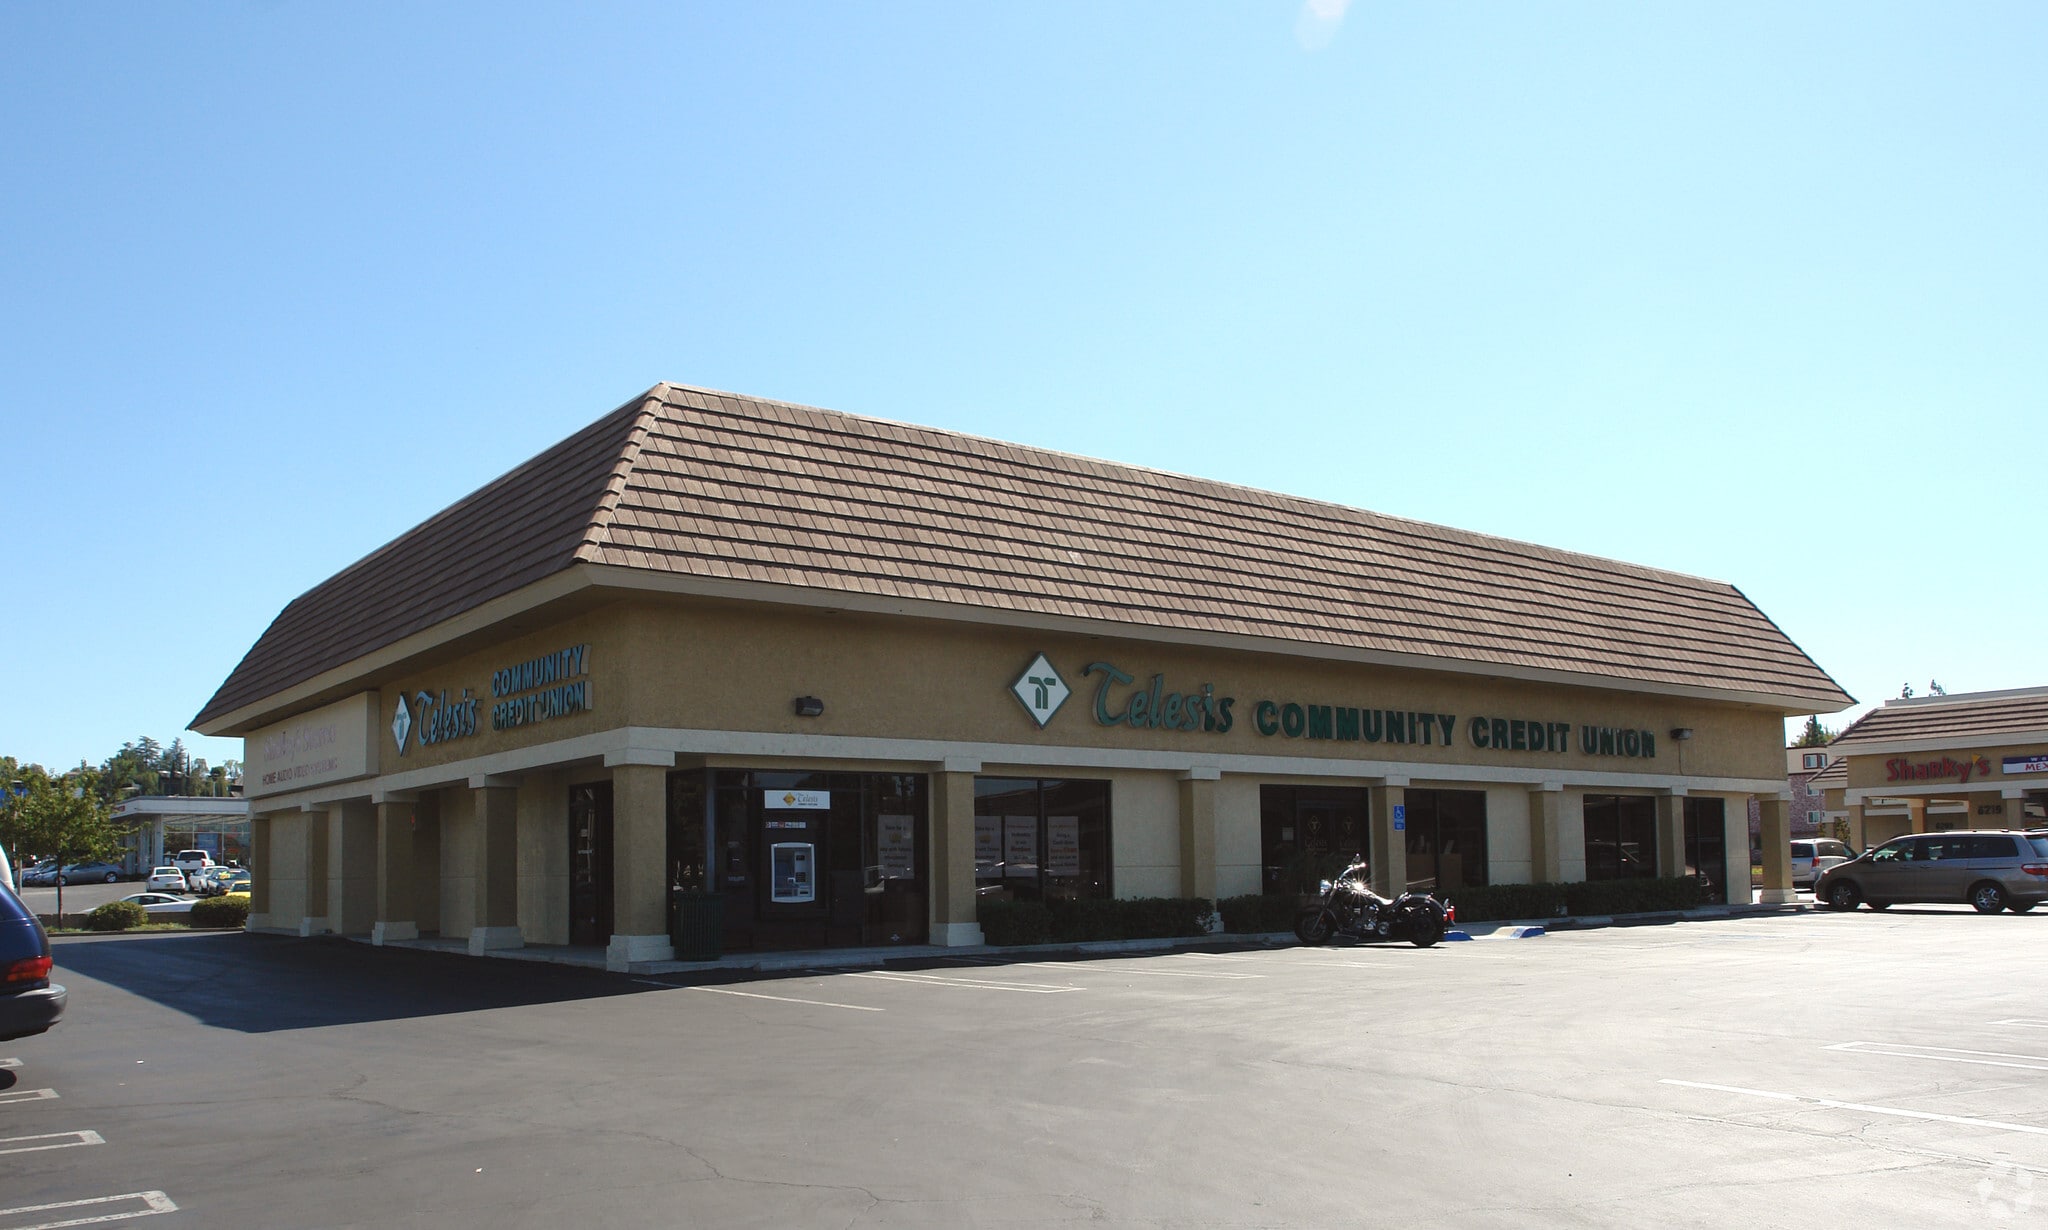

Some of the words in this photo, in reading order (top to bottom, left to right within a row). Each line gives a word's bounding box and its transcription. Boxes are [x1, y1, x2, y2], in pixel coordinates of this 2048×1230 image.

[491, 644, 588, 698] COMMUNITY
[415, 688, 480, 746] Telesis
[491, 694, 538, 731] CREDIT
[539, 681, 588, 720] UNION
[1081, 661, 1235, 733] Telesis
[1252, 699, 1456, 746] COMMUNITY
[1468, 716, 1570, 752] CREDIT
[1578, 724, 1656, 758] UNION
[262, 770, 277, 785] HOME
